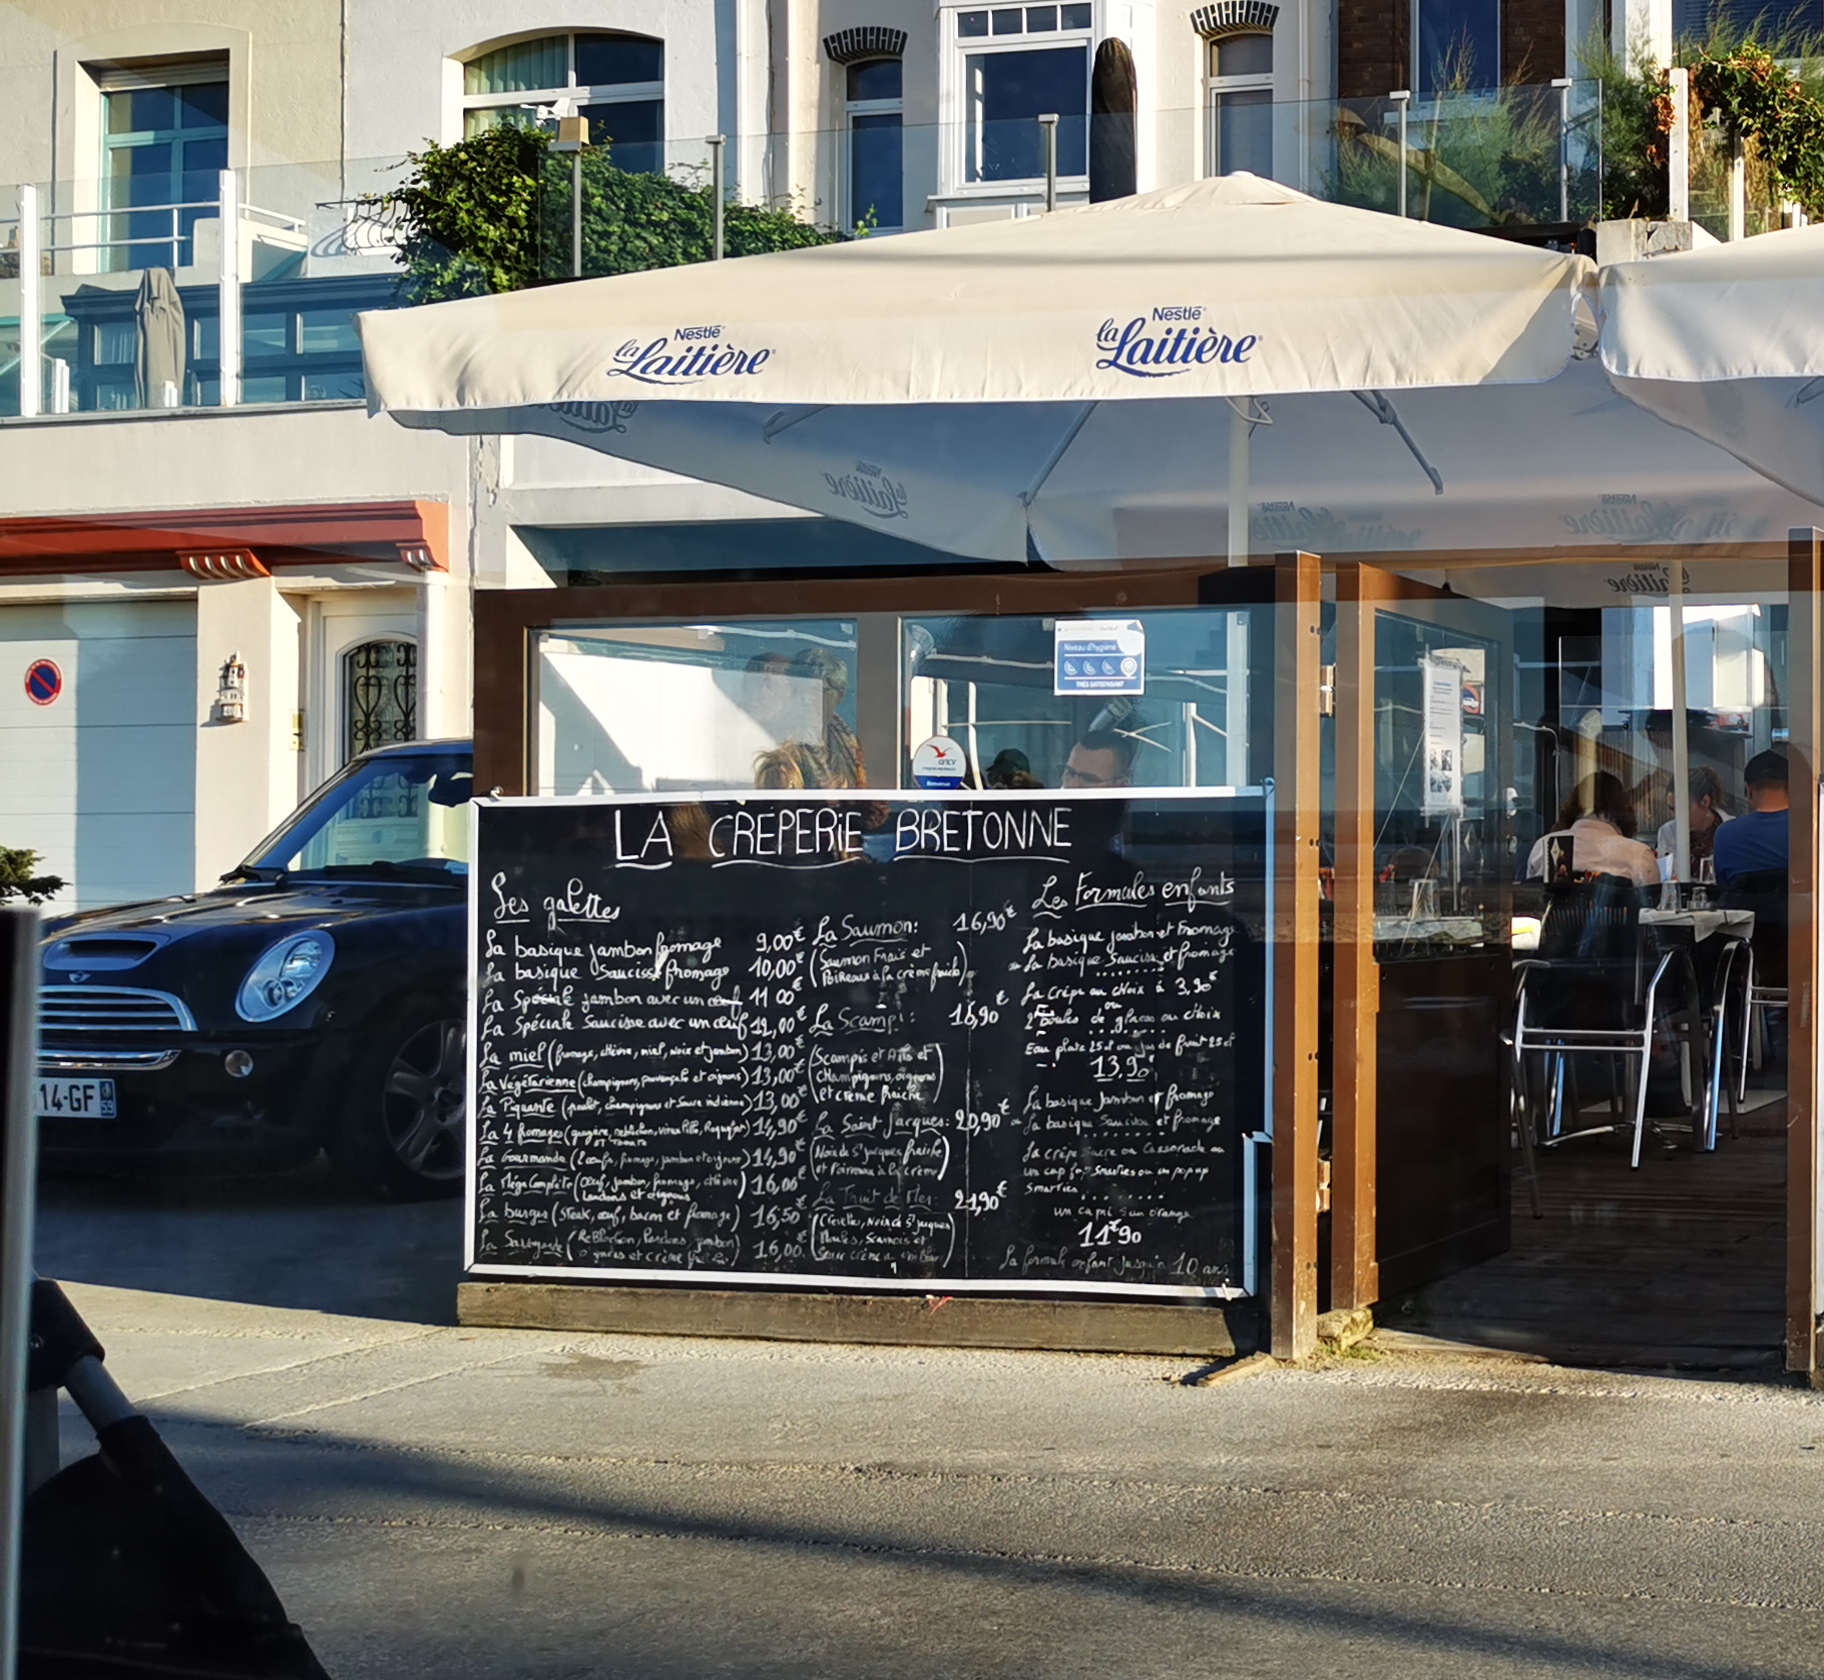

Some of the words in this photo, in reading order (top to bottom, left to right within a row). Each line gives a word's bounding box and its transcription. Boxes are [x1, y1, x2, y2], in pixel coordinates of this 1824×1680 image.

[1152, 306, 1202, 321] Nestlé
[674, 325, 722, 341] Nestlé
[1096, 318, 1119, 342] la
[607, 338, 770, 385] Laitière
[614, 339, 640, 358] la
[1096, 317, 1257, 378] Laitière
[615, 809, 673, 860] LA
[895, 808, 1073, 852] BRETONNE
[543, 877, 621, 930] galettes
[1032, 876, 1068, 909] Les
[1076, 871, 1154, 905] Formules
[1162, 867, 1234, 913] enfants
[515, 935, 584, 966] basique
[1047, 929, 1105, 954] basique
[515, 961, 583, 990] basique
